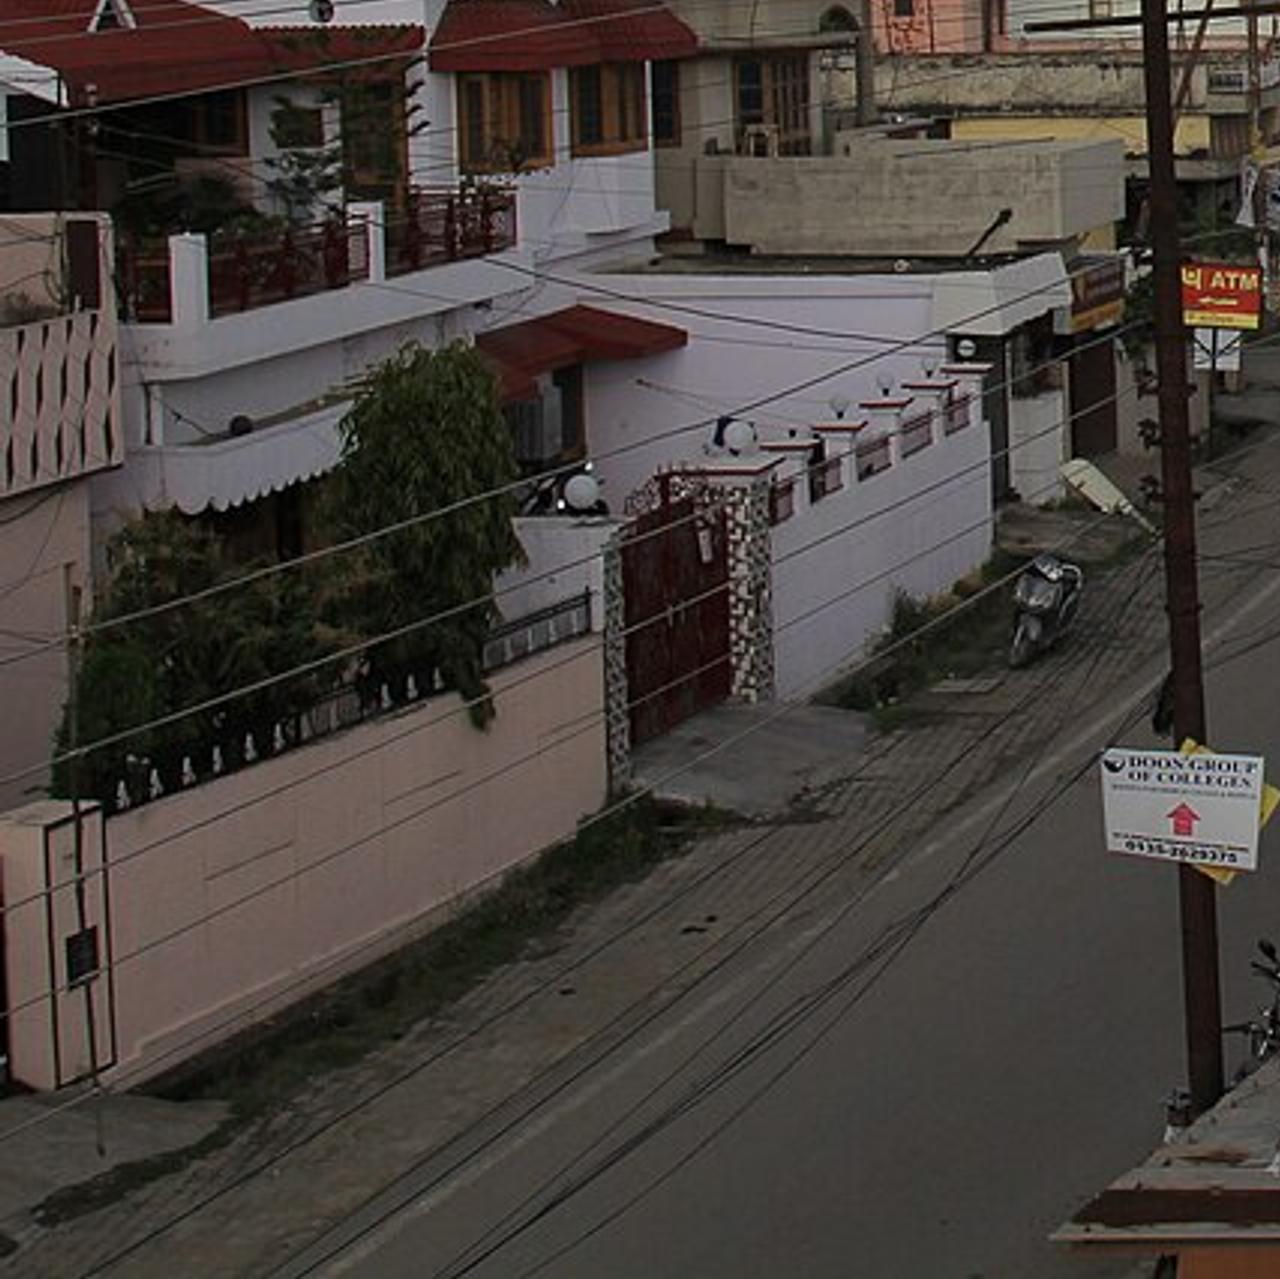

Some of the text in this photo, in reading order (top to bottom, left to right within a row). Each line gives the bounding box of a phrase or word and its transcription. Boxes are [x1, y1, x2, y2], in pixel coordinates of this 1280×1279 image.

[1211, 271, 1259, 290] ATM
[1128, 756, 1258, 773] DOON GROUP
[1128, 771, 1252, 788] OF COLLEGES
